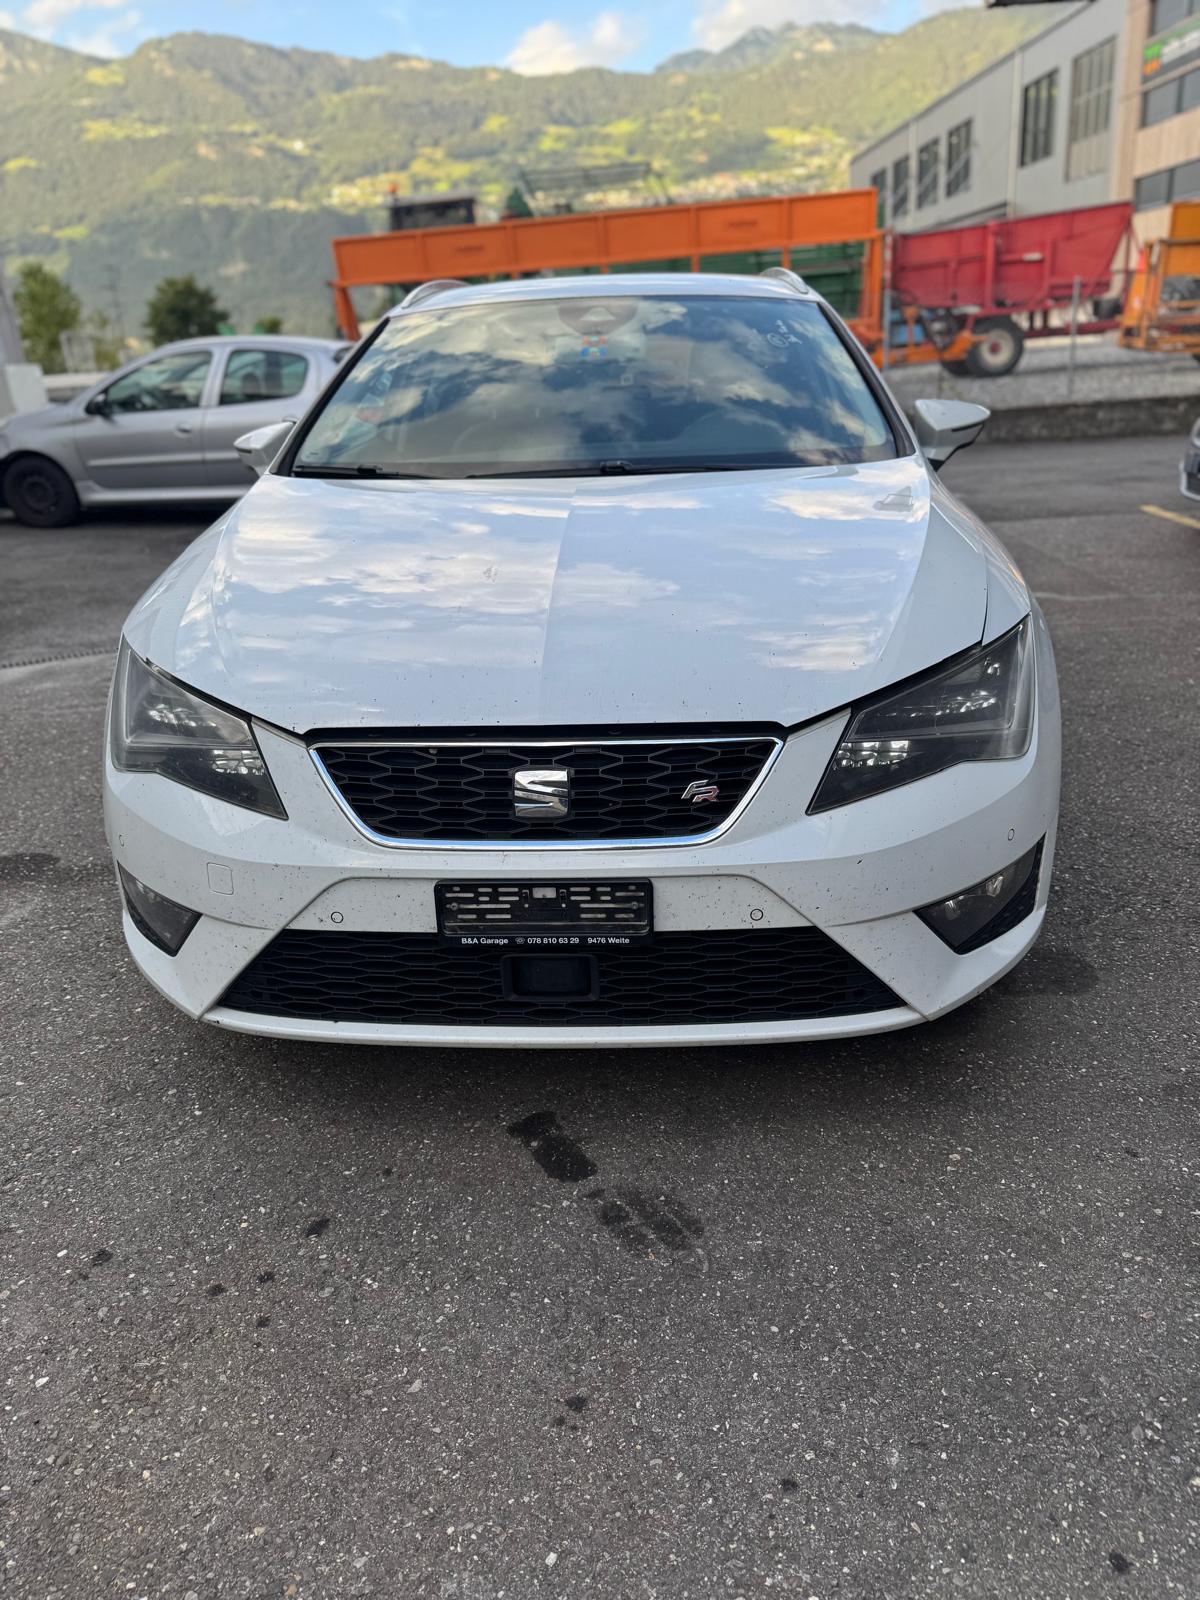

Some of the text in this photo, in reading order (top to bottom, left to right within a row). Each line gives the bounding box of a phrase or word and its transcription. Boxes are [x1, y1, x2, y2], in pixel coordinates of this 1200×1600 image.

[681, 779, 720, 803] FR
[461, 937, 479, 945] B&A
[480, 937, 509, 946] Garage
[527, 937, 542, 945] 078
[543, 937, 557, 945] 810
[558, 937, 568, 945] 63
[569, 937, 580, 945] 29
[587, 937, 606, 945] 9476
